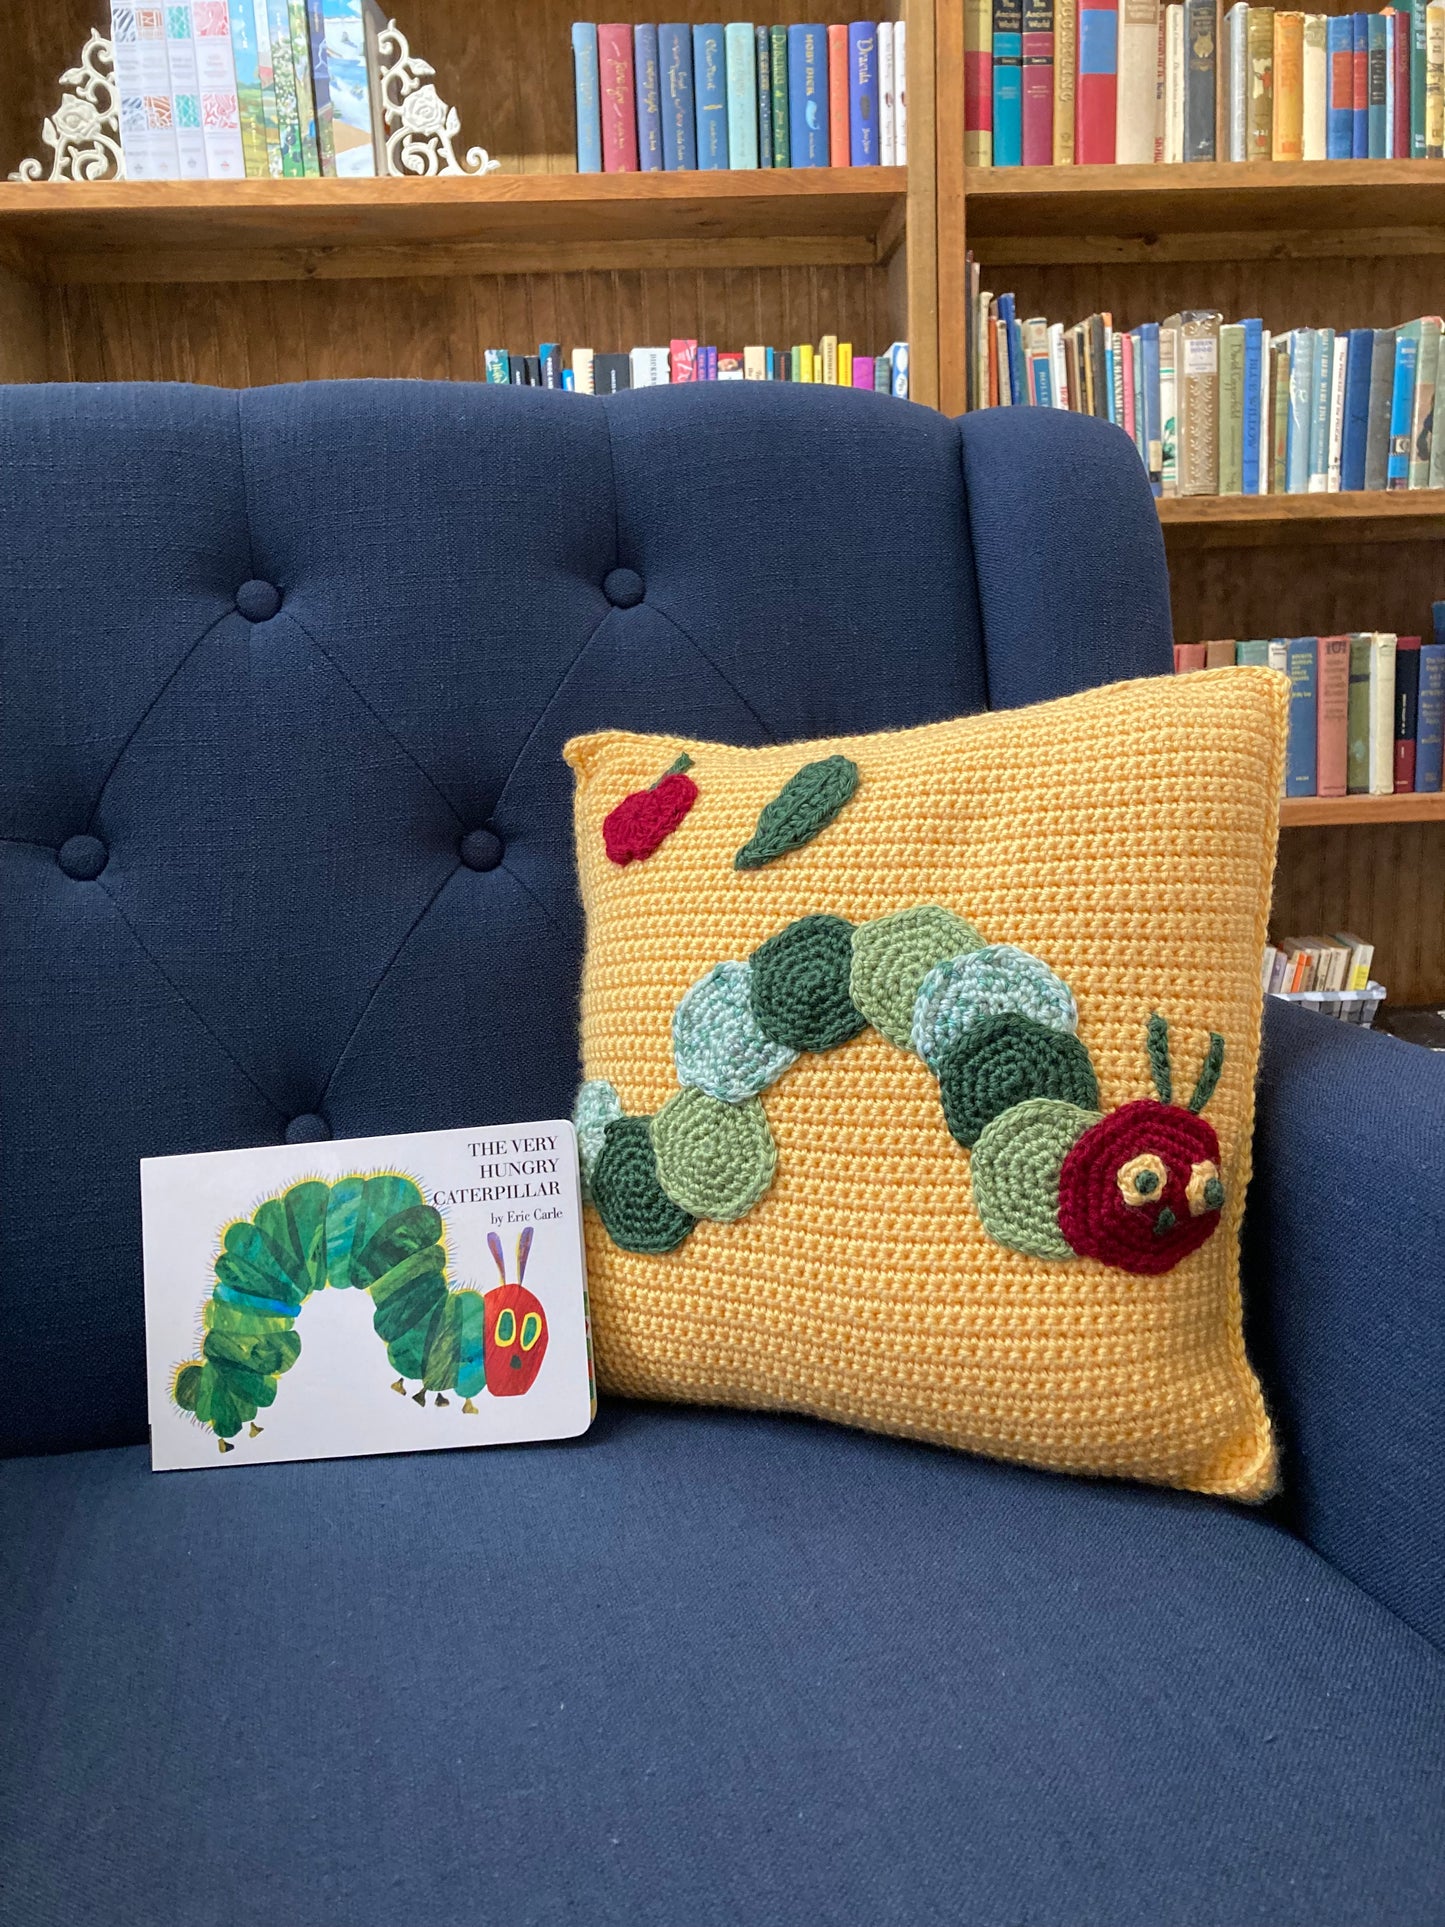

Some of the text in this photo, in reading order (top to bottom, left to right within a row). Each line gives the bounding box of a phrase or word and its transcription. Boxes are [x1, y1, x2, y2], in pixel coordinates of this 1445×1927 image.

[1026, 10, 1052, 18] Ancient
[1028, 20, 1050, 28] World
[805, 33, 815, 96] MOBY DICK
[857, 37, 874, 85] Dracula
[1224, 343, 1242, 420] David Copperfield
[468, 1136, 559, 1158] THE VERY
[480, 1158, 560, 1179] HUNGRY
[433, 1181, 561, 1206] CATERPILLAR
[491, 1207, 563, 1227] by Eric Carle
